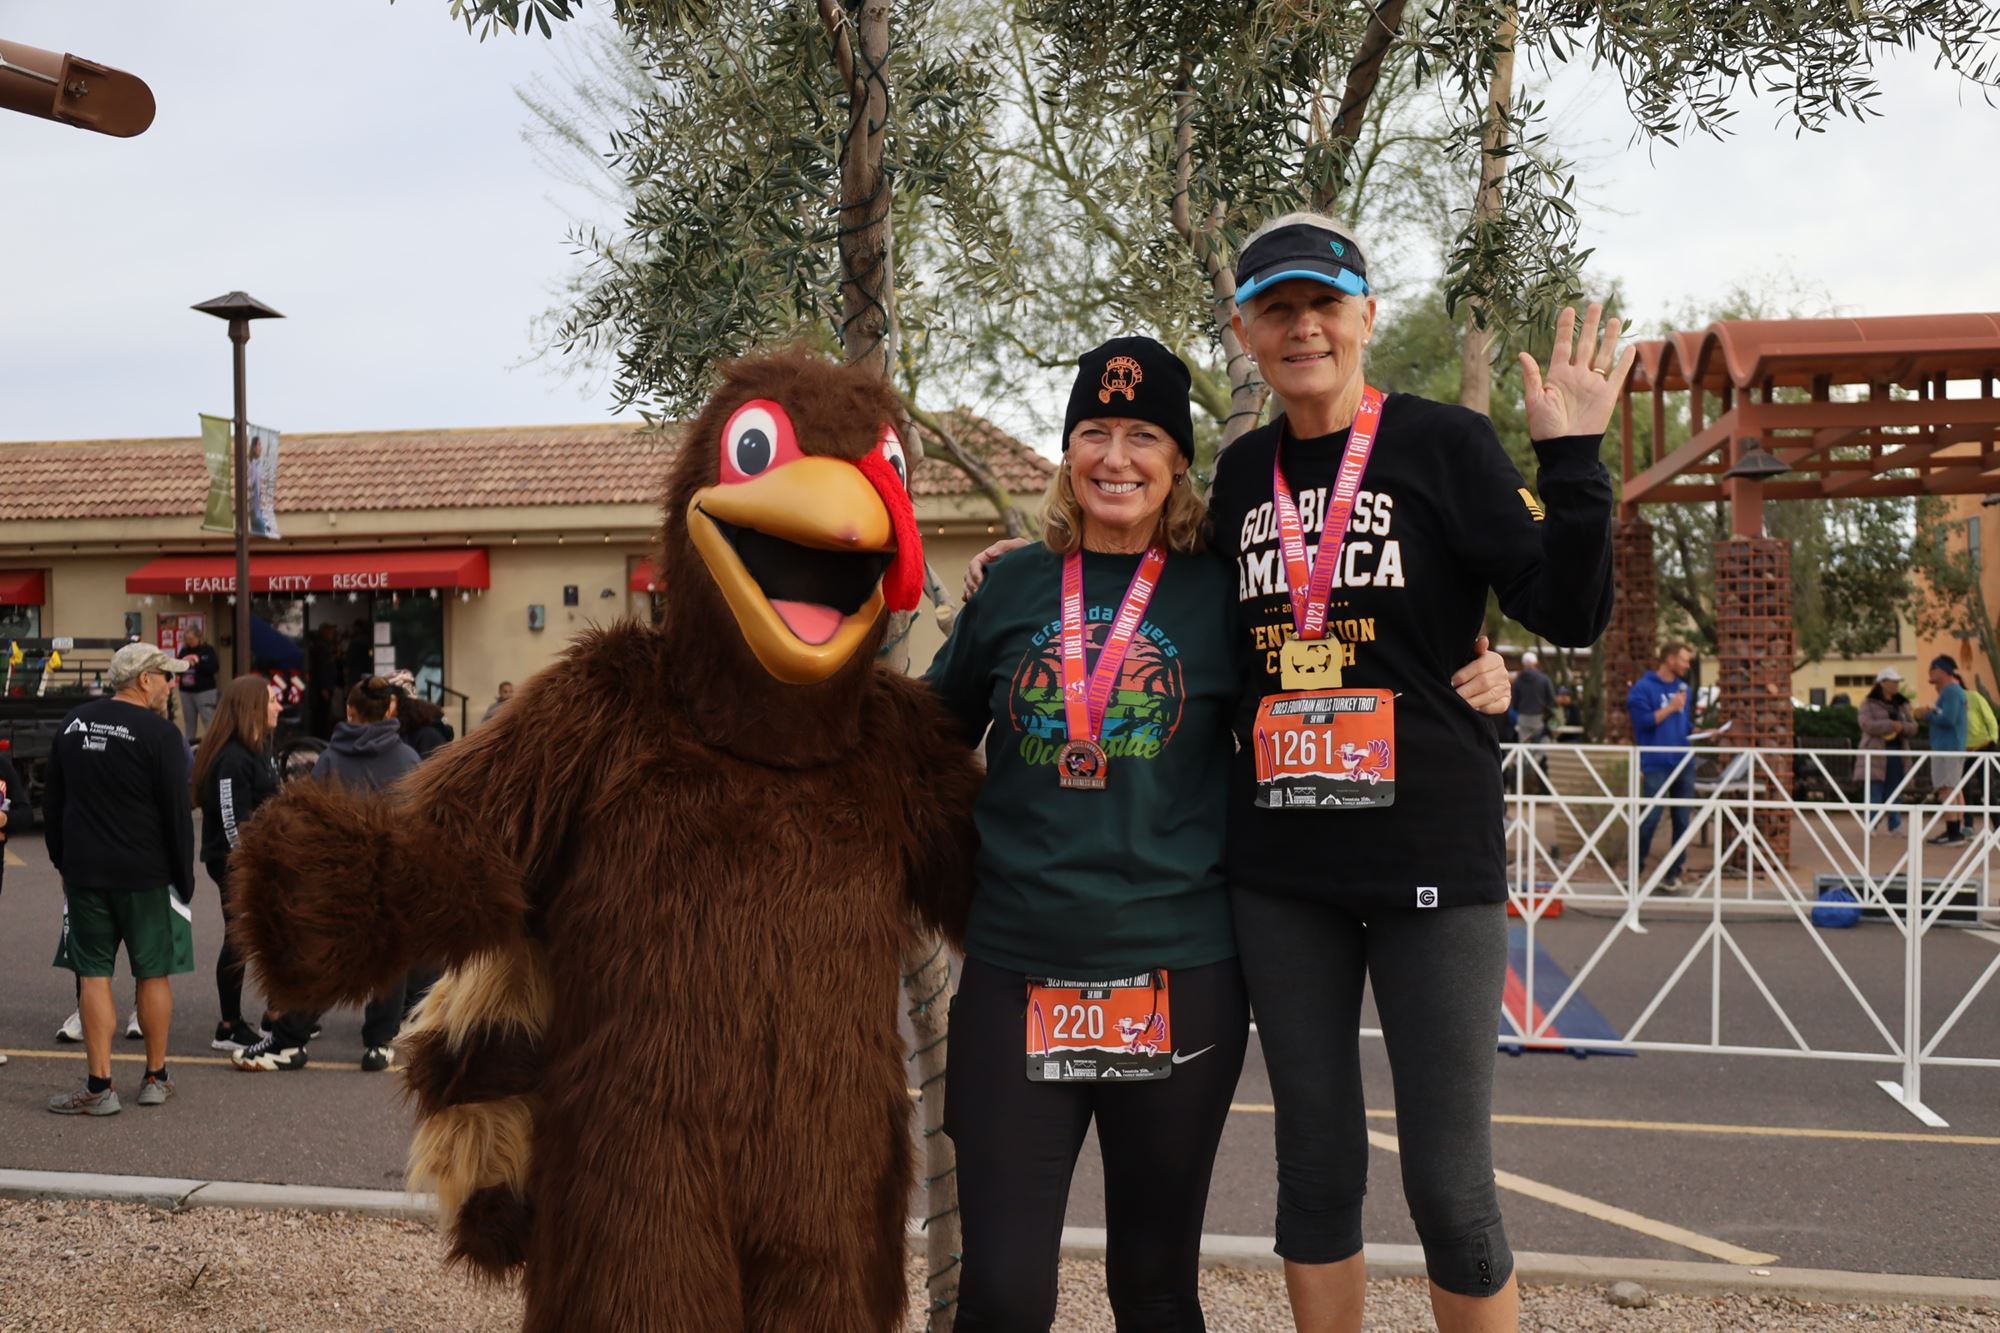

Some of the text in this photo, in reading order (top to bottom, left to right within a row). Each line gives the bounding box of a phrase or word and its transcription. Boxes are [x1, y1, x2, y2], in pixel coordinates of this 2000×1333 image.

[1299, 488, 1393, 537] BLSS
[1284, 534, 1305, 563] TROT
[1304, 432, 1372, 632] 2023 FOUNTAIN HILLS TURKEY TROT
[185, 572, 388, 591] FEARLE KITTY RESCUE
[1064, 592, 1081, 631] TURKEY
[1100, 643, 1124, 674] HILLS
[1112, 601, 1142, 642] TURKEY
[1129, 576, 1153, 604] TROT
[1065, 634, 1082, 660] TROT
[1272, 697, 1375, 715] 2023 FOUNTAIN HILLS TURKEY TROT
[1271, 730, 1333, 766] 1261
[1134, 973, 1150, 986] TROT
[1052, 1004, 1104, 1039] 220
